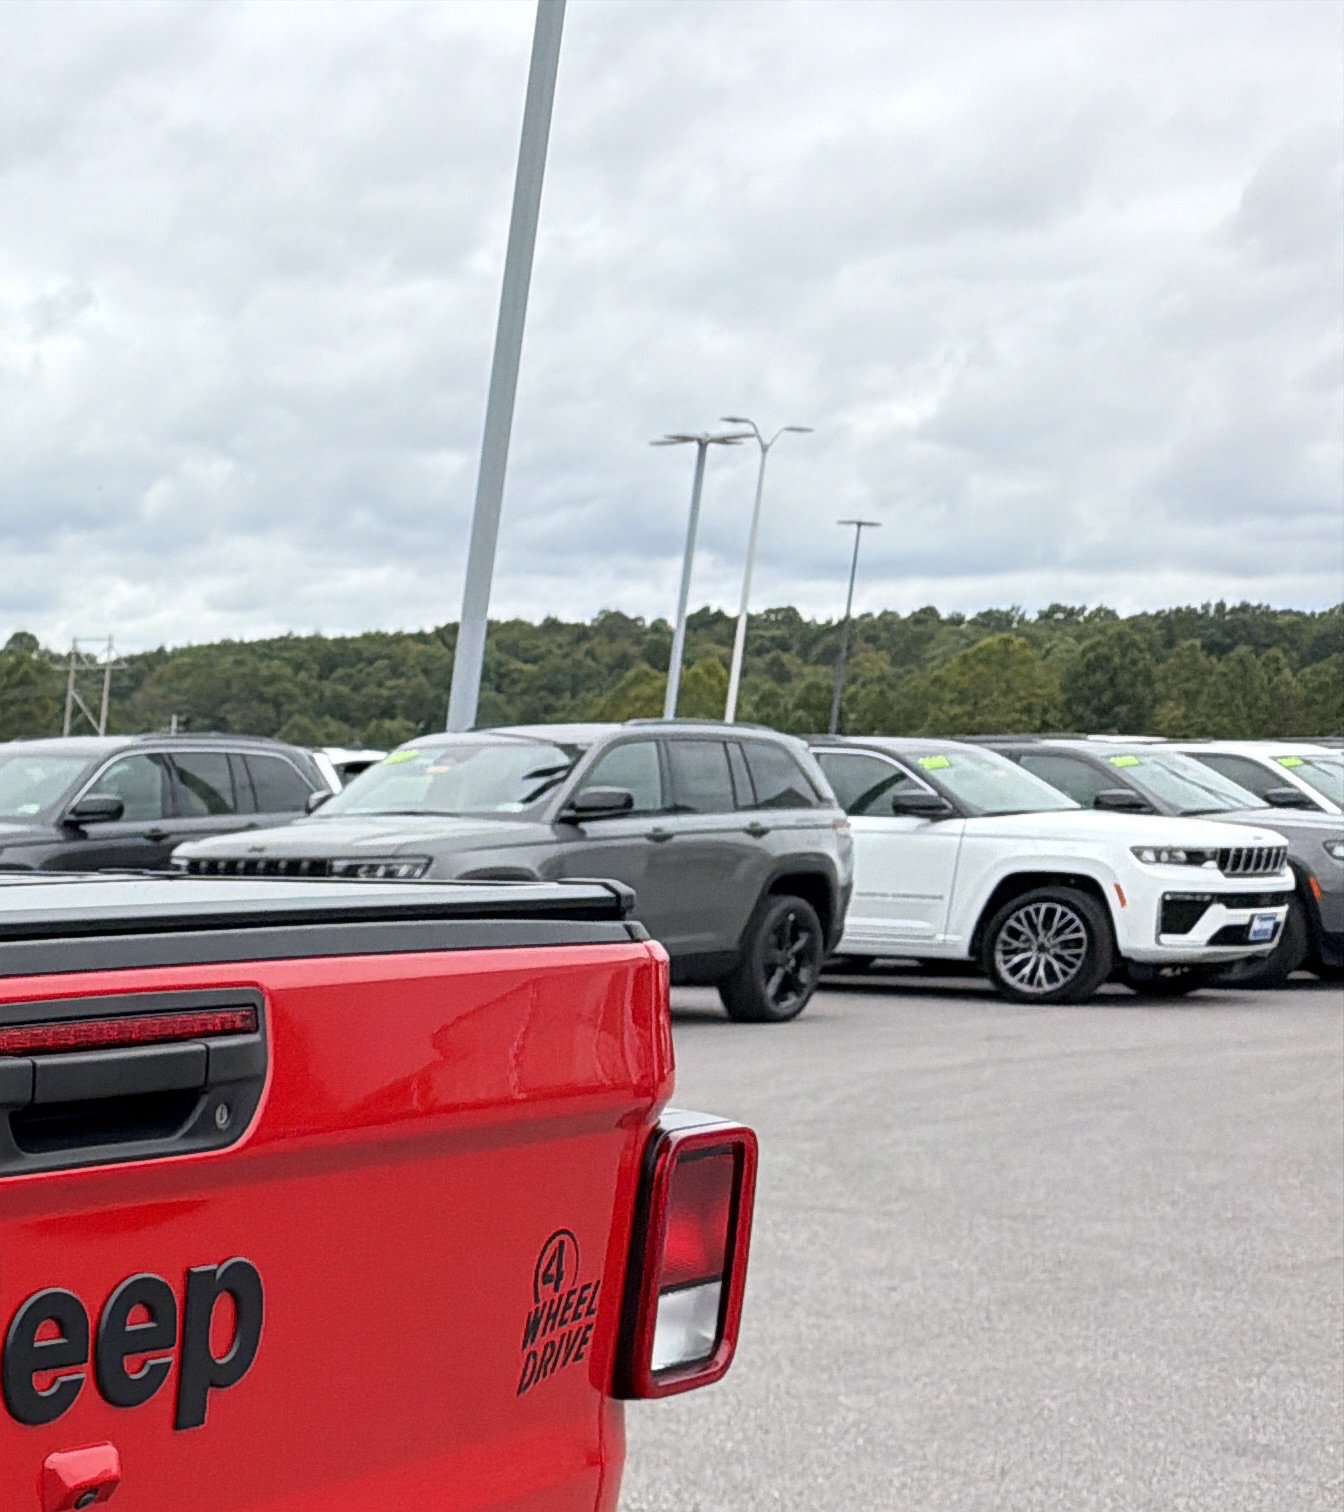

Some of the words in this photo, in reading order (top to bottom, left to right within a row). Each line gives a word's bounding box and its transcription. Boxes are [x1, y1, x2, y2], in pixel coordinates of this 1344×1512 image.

[541, 1239, 565, 1293] 4
[522, 1279, 601, 1351] WHEEL
[516, 1322, 595, 1397] DRIVE
